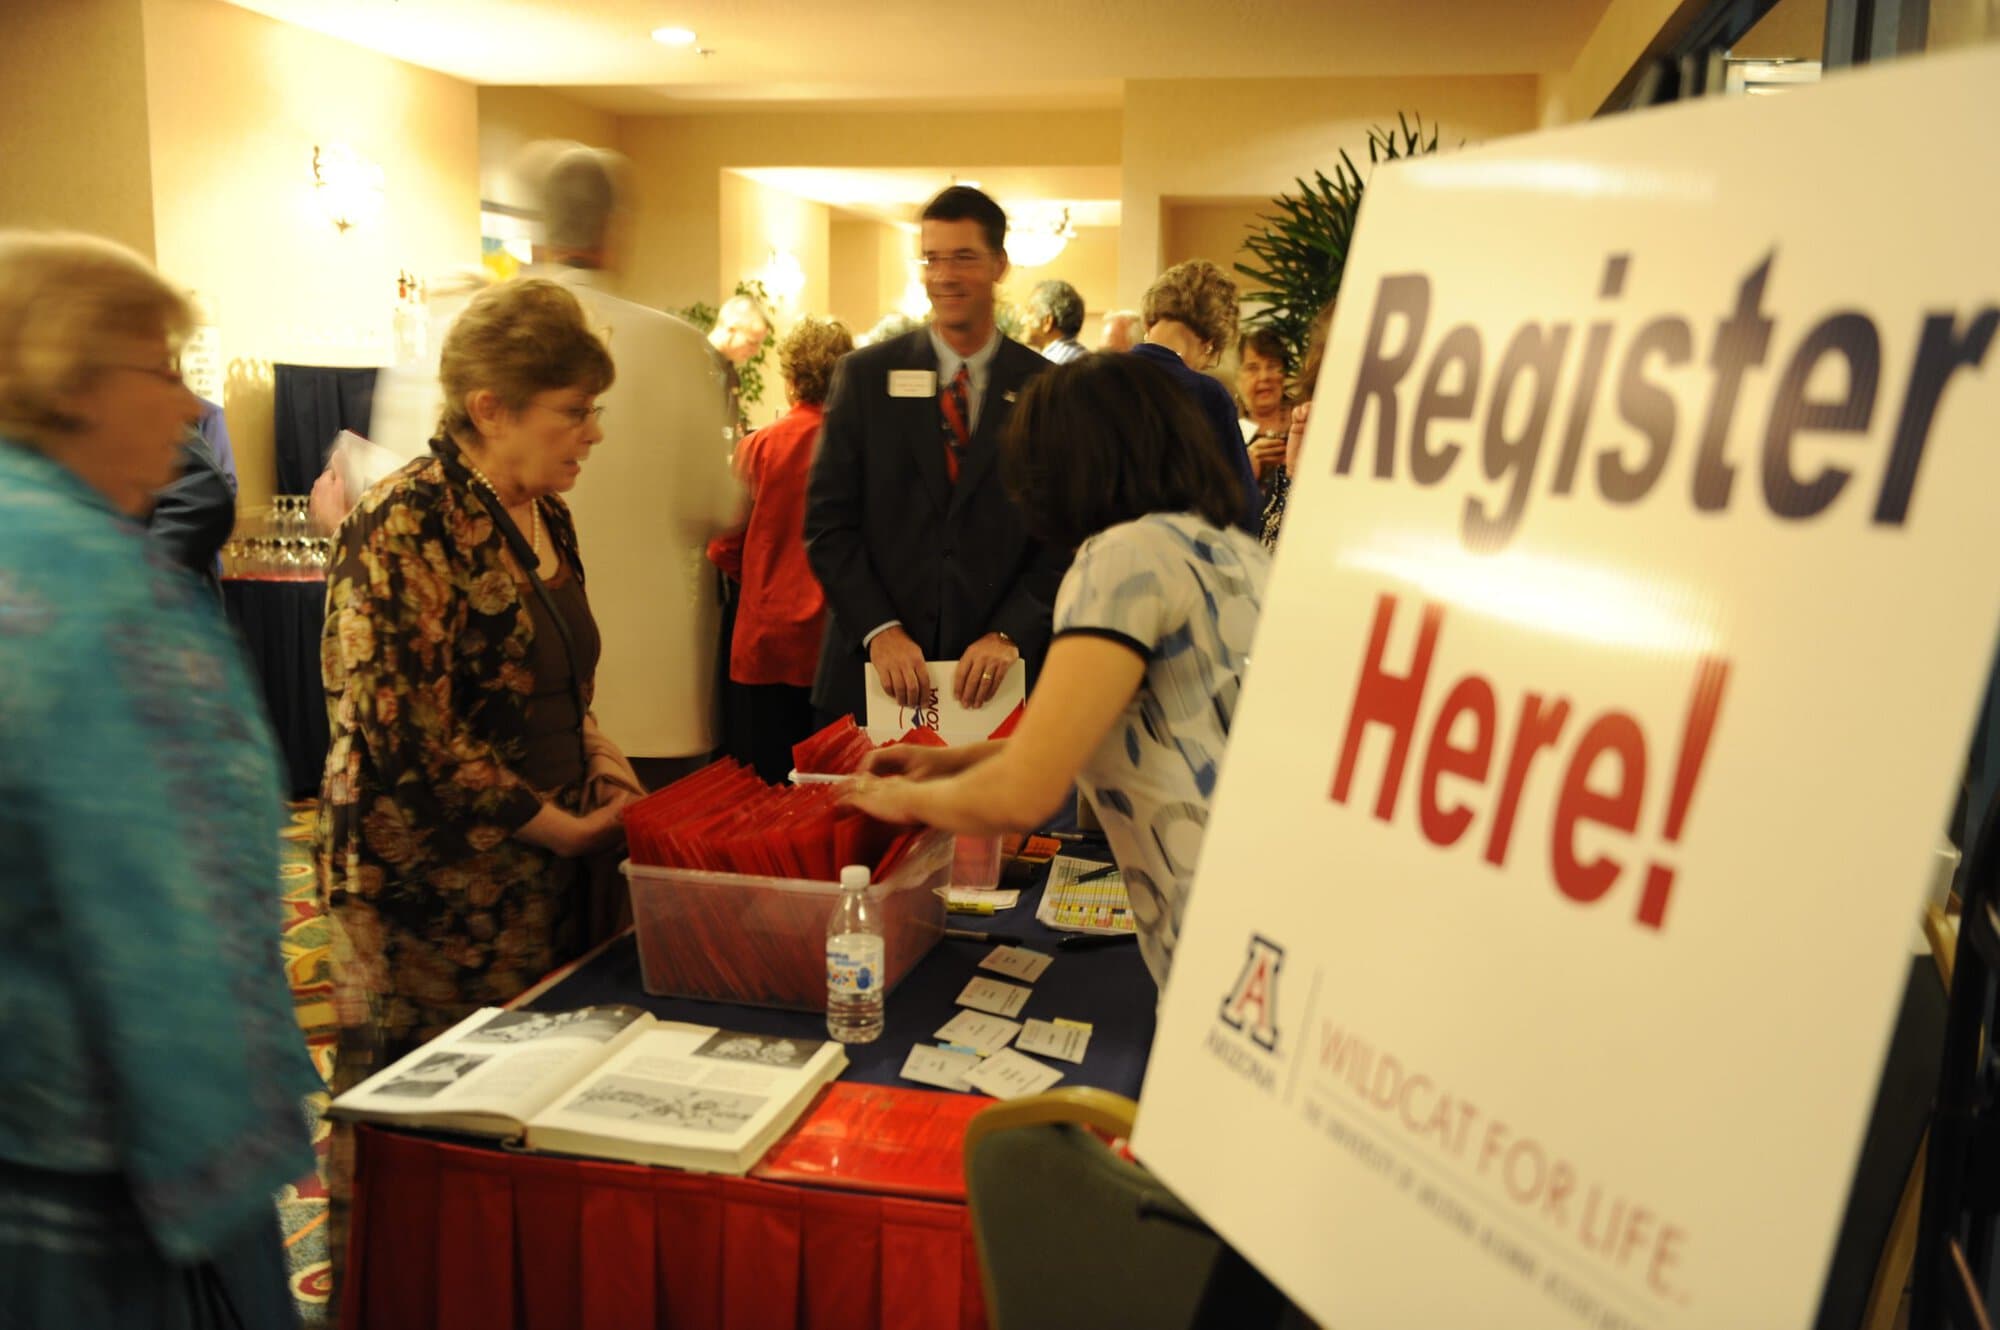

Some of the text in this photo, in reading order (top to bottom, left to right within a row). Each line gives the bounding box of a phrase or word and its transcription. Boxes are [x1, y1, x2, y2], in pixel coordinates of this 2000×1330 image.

[1333, 247, 2000, 552] Register
[1330, 595, 1731, 931] Here!
[1320, 1019, 1480, 1157] WILDCAT
[1477, 1119, 1577, 1227] FOR
